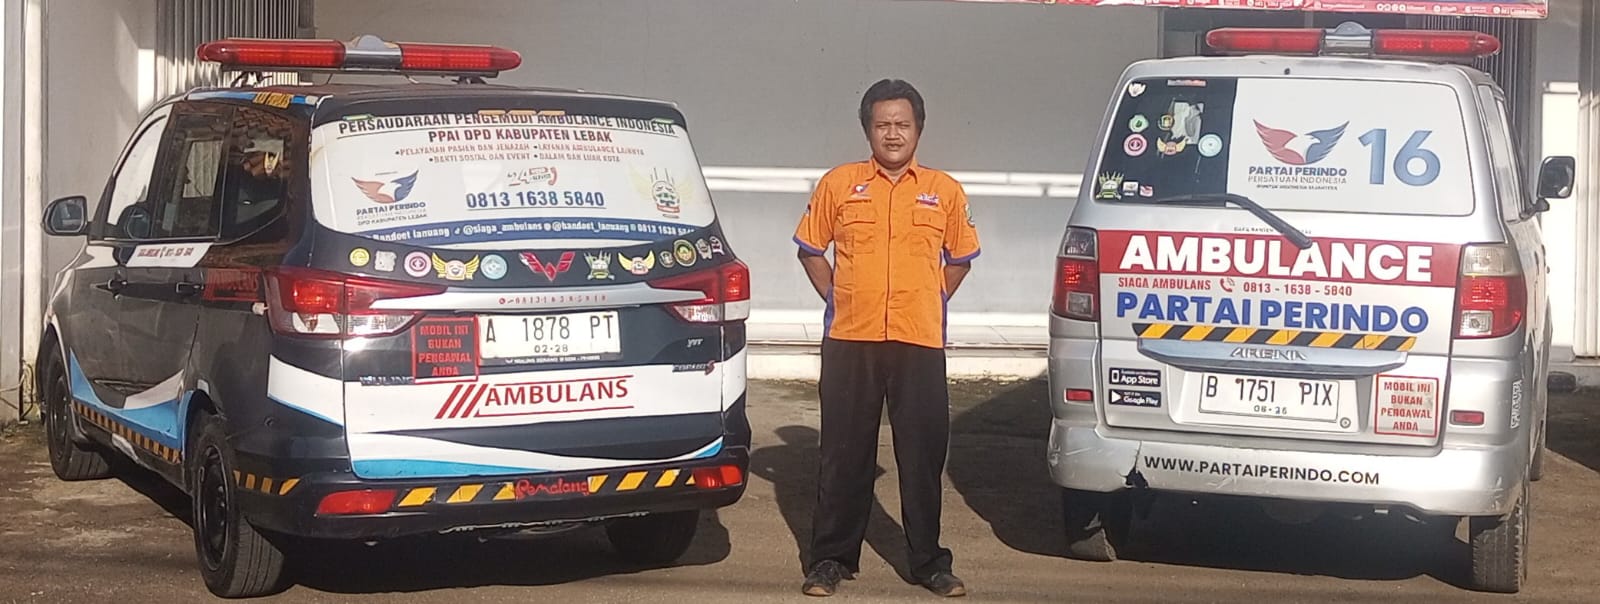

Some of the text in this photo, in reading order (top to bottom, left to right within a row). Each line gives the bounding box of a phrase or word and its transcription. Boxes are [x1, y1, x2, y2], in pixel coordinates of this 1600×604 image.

[338, 113, 676, 135] PERSAUDARAAN PENGEMUDI AMBULANCE INDONESIA
[428, 128, 613, 143] PPAI DPD KABUPATEN LEBAK
[1358, 128, 1441, 187] 16
[1248, 166, 1348, 177] PARTAI PERINDO
[1248, 175, 1347, 184] PERSATUAN INDONESIA
[466, 190, 605, 208] 0813 1638 5840
[356, 205, 388, 216] PARTAI
[389, 201, 426, 212] PERINDO
[1119, 234, 1433, 283] AMBULANCE
[1118, 277, 1212, 291] SIAGA AMBULANS
[1243, 281, 1271, 294] 0813
[1284, 283, 1312, 296] 1638
[1324, 285, 1353, 297] 5840
[1116, 291, 1429, 334] PARTAI PERINDO
[420, 324, 469, 335] MOBIL INI
[486, 313, 614, 343] A 1878 PT
[427, 338, 462, 349] BUKAN
[418, 352, 472, 363] PENGAWAL
[1230, 346, 1307, 361] ARENA
[431, 366, 460, 377] ANDA
[1120, 375, 1159, 385] App Store
[1384, 381, 1431, 393] MOBIL INI
[484, 378, 629, 407] AMBULANS
[1206, 375, 1334, 407] B 1751 PIX
[1123, 396, 1145, 406] Google
[1391, 394, 1423, 405] BUKAN
[1381, 407, 1433, 419] PENGAWAL
[1392, 421, 1419, 432] ANDA
[1144, 455, 1380, 486] WWW.PARTAIPERINDO.COM
